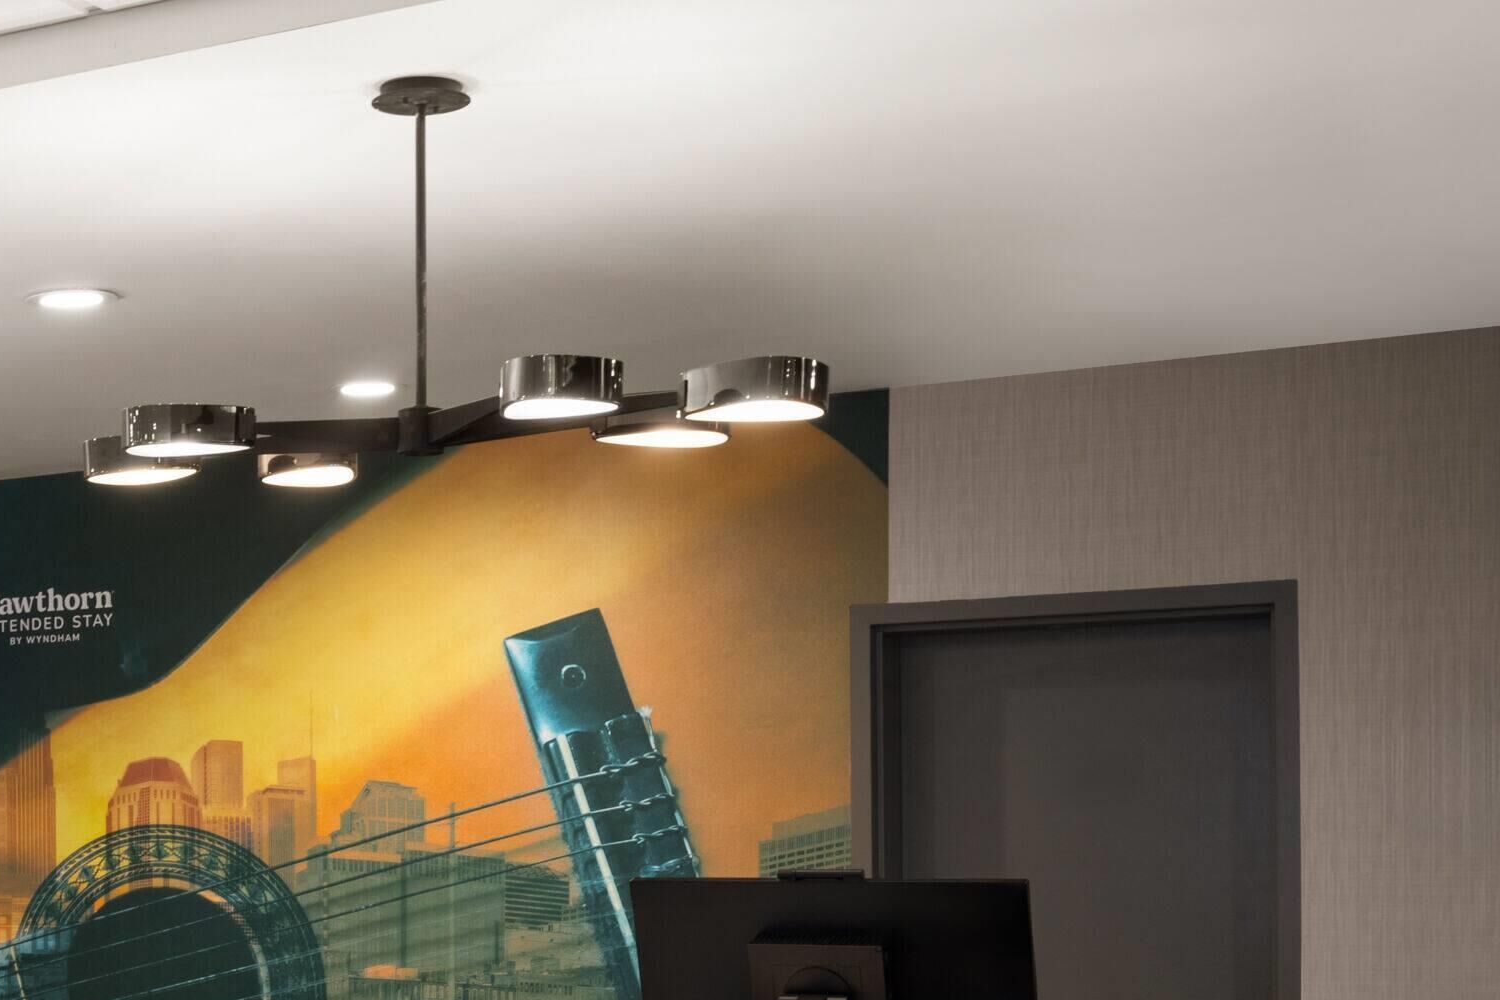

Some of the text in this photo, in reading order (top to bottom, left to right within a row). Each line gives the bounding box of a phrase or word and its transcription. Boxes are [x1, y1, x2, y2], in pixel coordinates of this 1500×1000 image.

[72, 613, 113, 629] STAY
[9, 633, 80, 646] BY WYNDHAM
